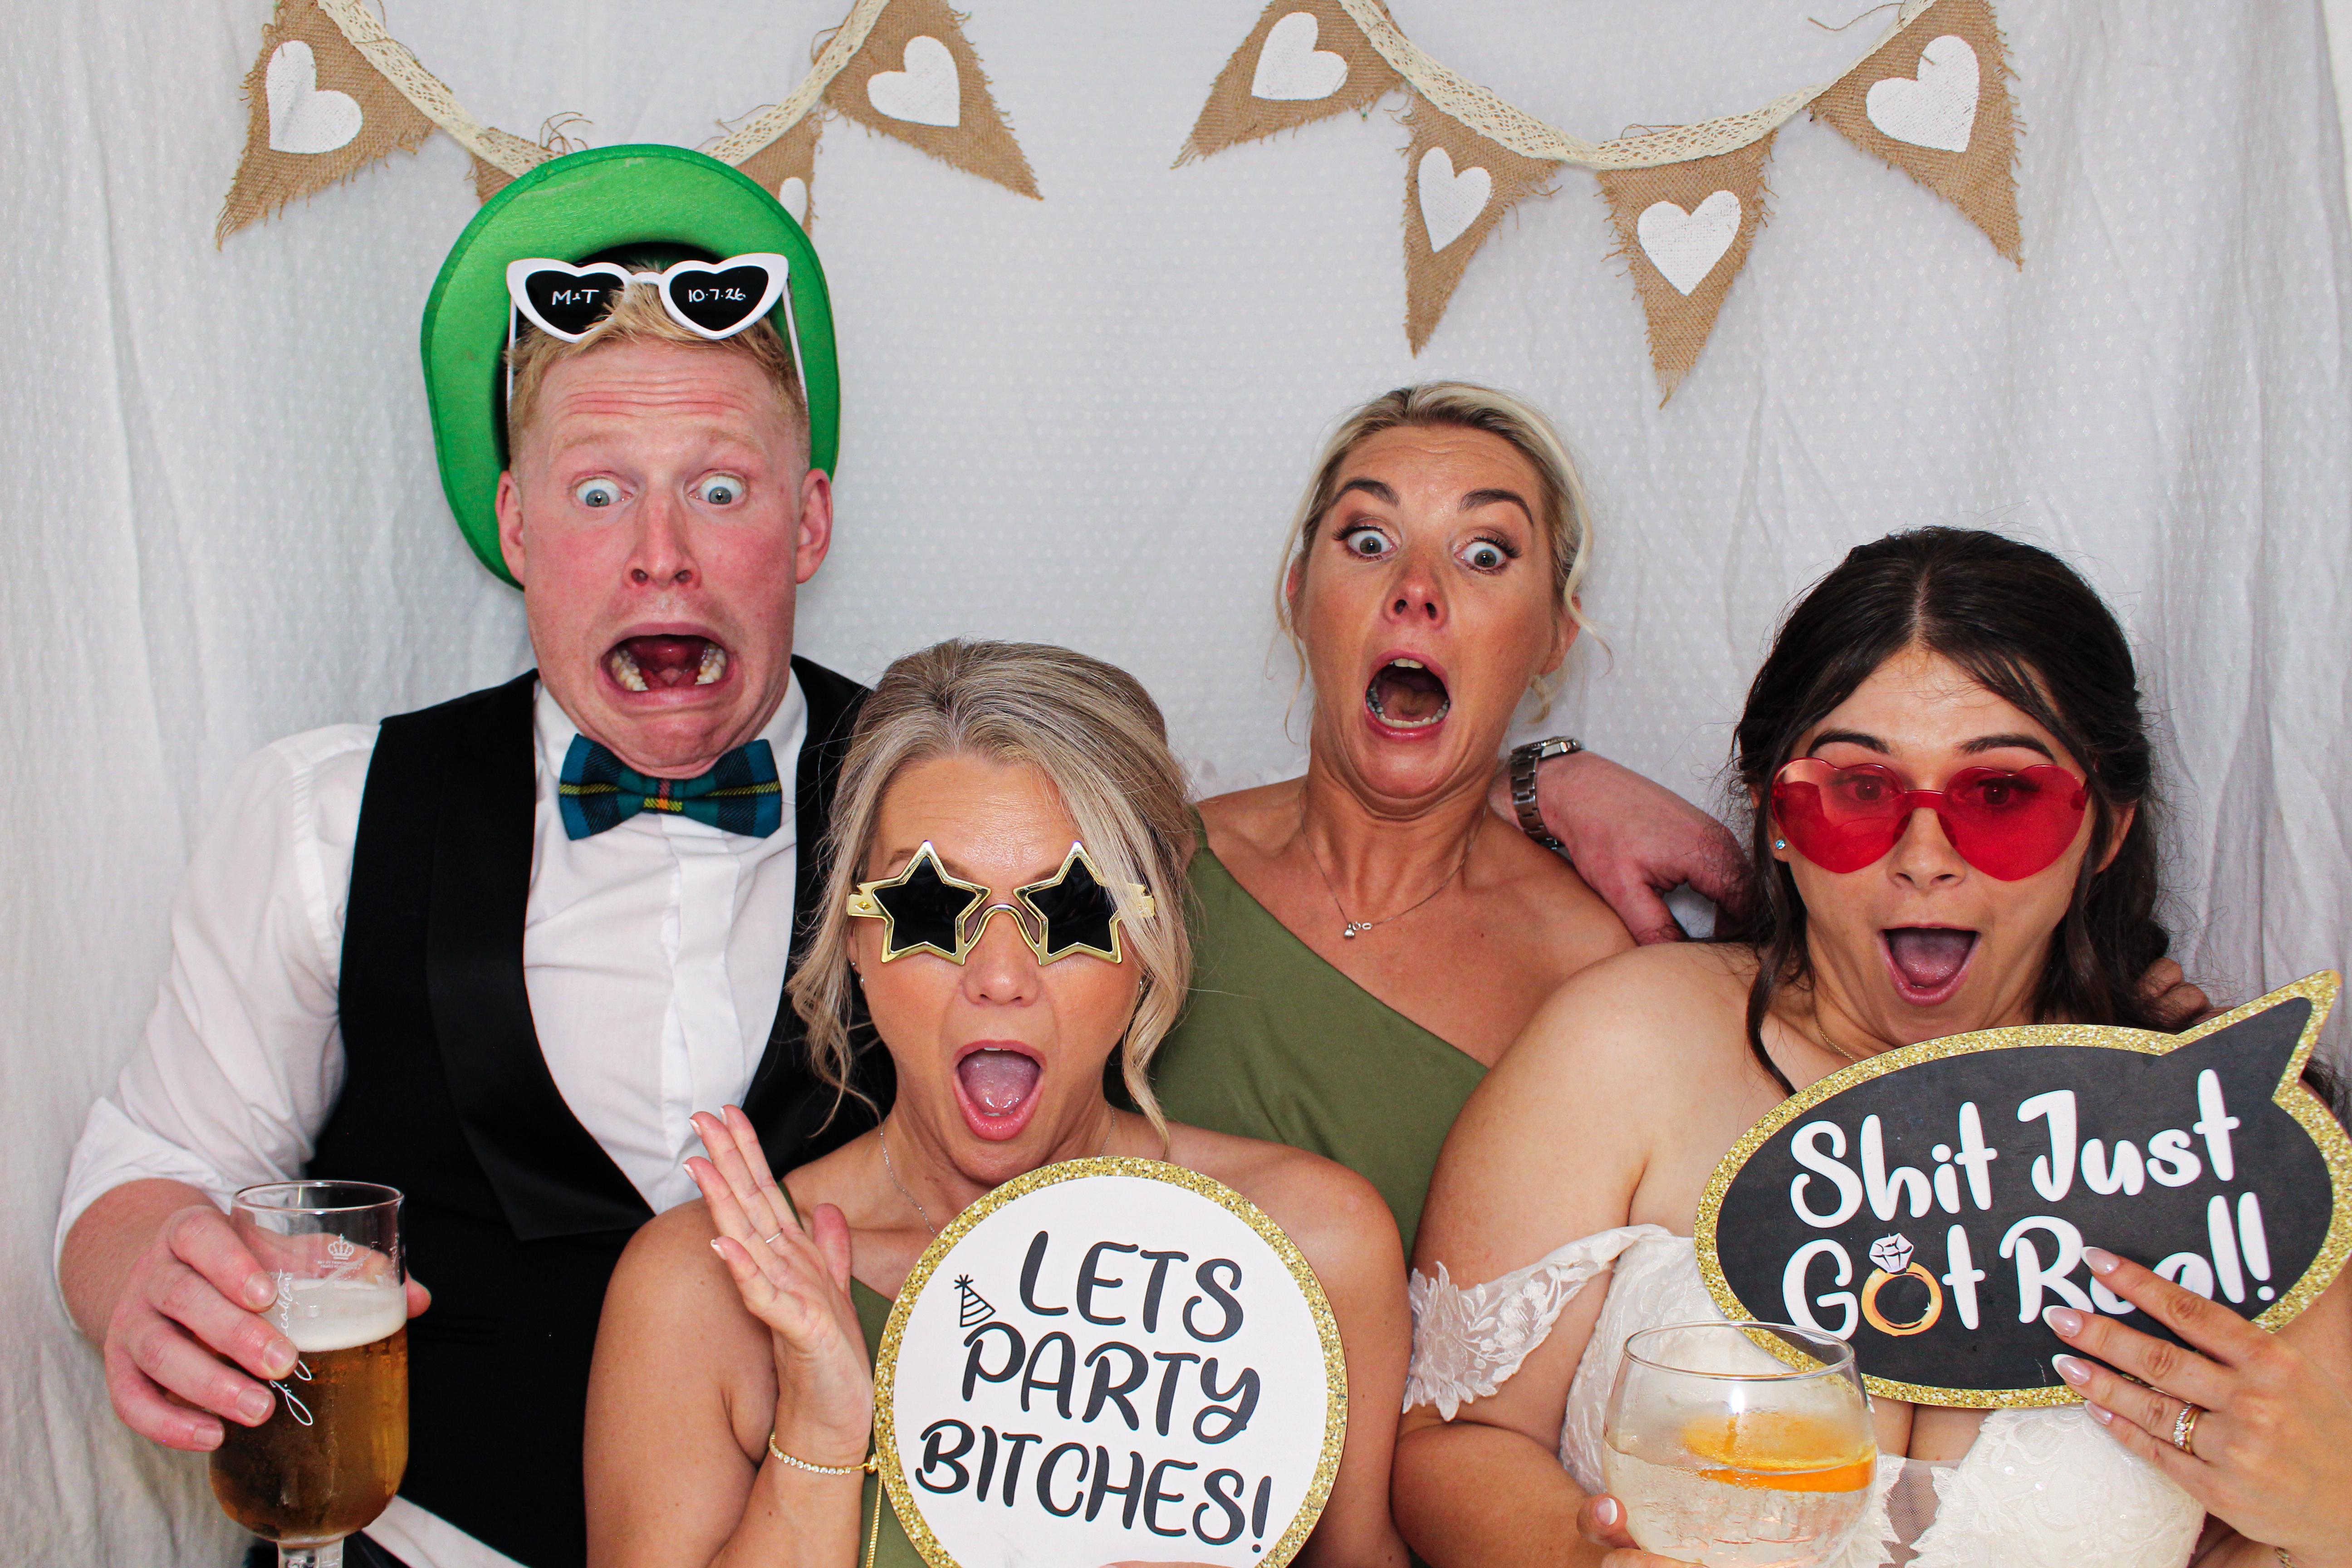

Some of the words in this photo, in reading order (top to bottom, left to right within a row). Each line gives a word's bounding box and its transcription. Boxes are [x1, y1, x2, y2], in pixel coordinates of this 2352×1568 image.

[1790, 1102, 1998, 1228] Shit
[2017, 1068, 2240, 1202] Just
[1019, 1231, 1244, 1343] LETS
[962, 1321, 1260, 1445] PARTY
[915, 1419, 1272, 1553] BITCHES!
